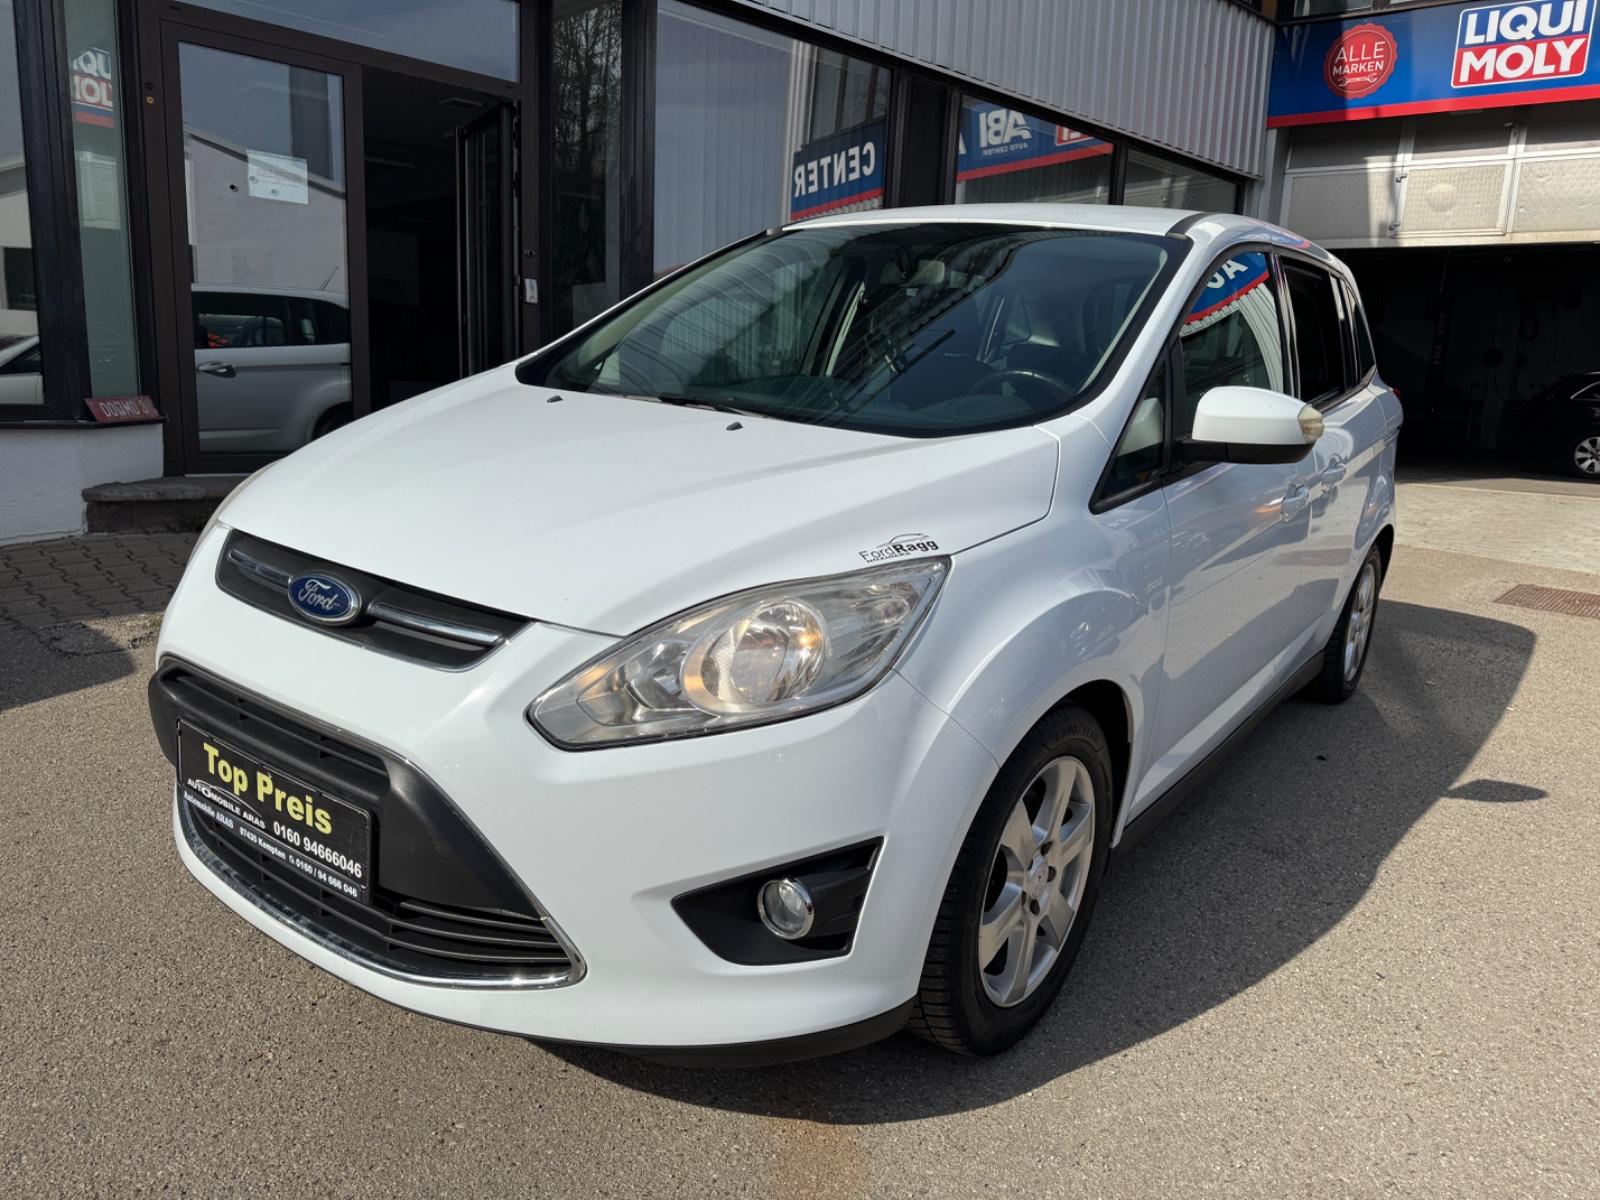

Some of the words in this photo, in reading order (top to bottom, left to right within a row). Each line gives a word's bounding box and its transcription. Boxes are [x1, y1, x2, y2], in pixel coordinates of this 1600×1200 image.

[1464, 0, 1588, 45] LIQUI
[1332, 60, 1385, 76] MARKEN
[1335, 41, 1386, 64] ALLE
[1459, 38, 1587, 83] MOLY
[74, 75, 113, 107] OL
[297, 579, 339, 611] Ford
[187, 778, 242, 815] AUTOMOBILE
[242, 811, 266, 829] ARAS
[203, 742, 248, 796] Top
[256, 771, 333, 835] Preis
[258, 837, 287, 860] Kempten
[295, 858, 313, 875] 0160
[273, 821, 301, 847] 0160
[303, 837, 363, 879] 94666046
